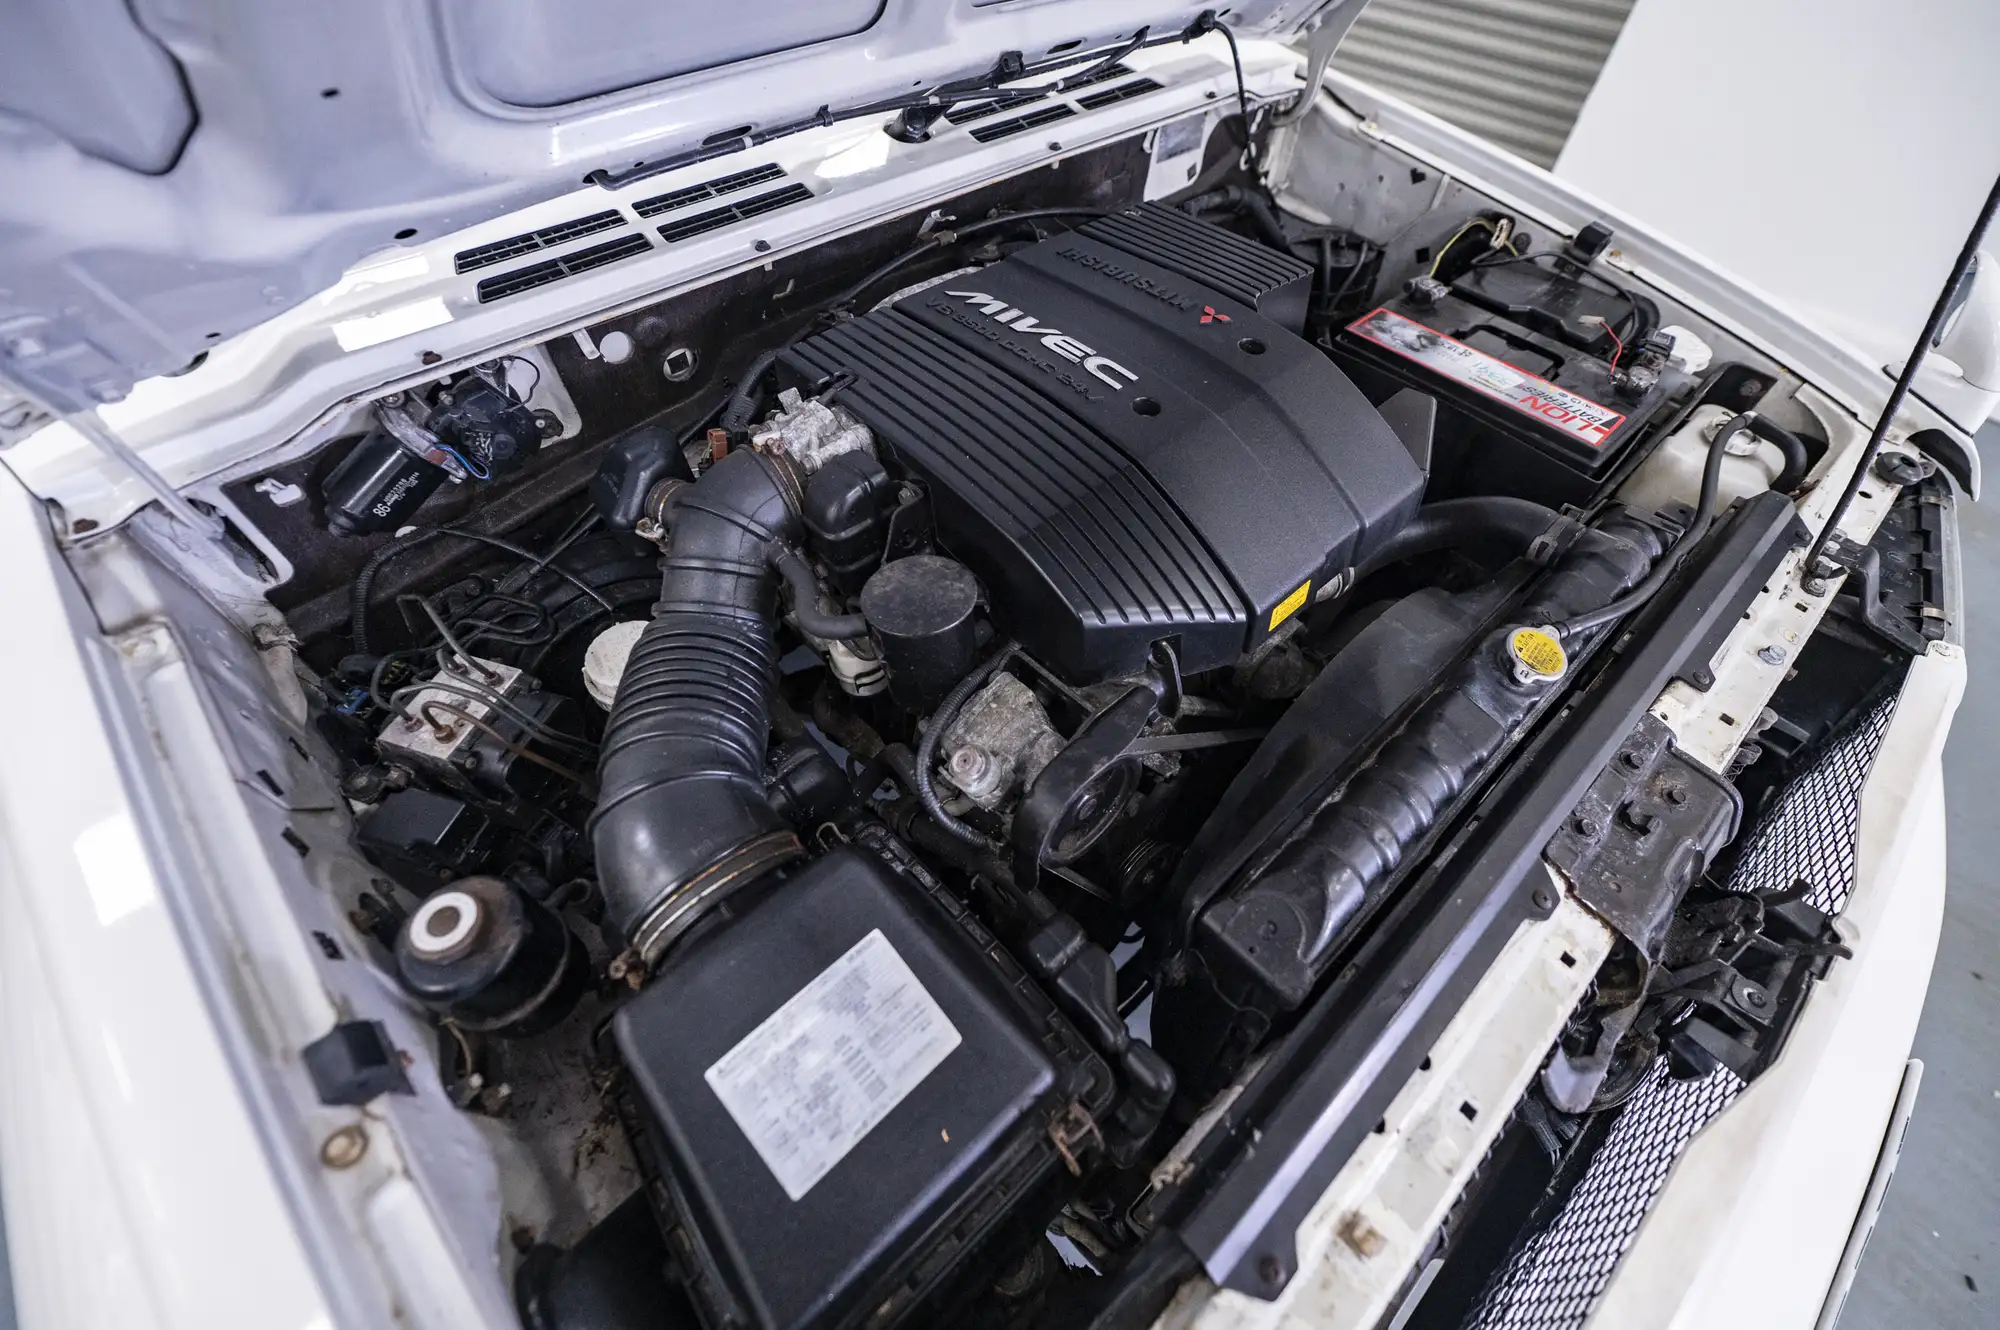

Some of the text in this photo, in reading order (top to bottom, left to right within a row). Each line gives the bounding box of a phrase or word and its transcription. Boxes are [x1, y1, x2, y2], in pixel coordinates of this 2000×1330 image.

[1056, 248, 1198, 312] MITSUBISHI
[925, 297, 956, 316] V6
[944, 290, 1139, 391] MIVEC
[1518, 395, 1594, 432] LION
[1523, 386, 1604, 423] BATTERIES
